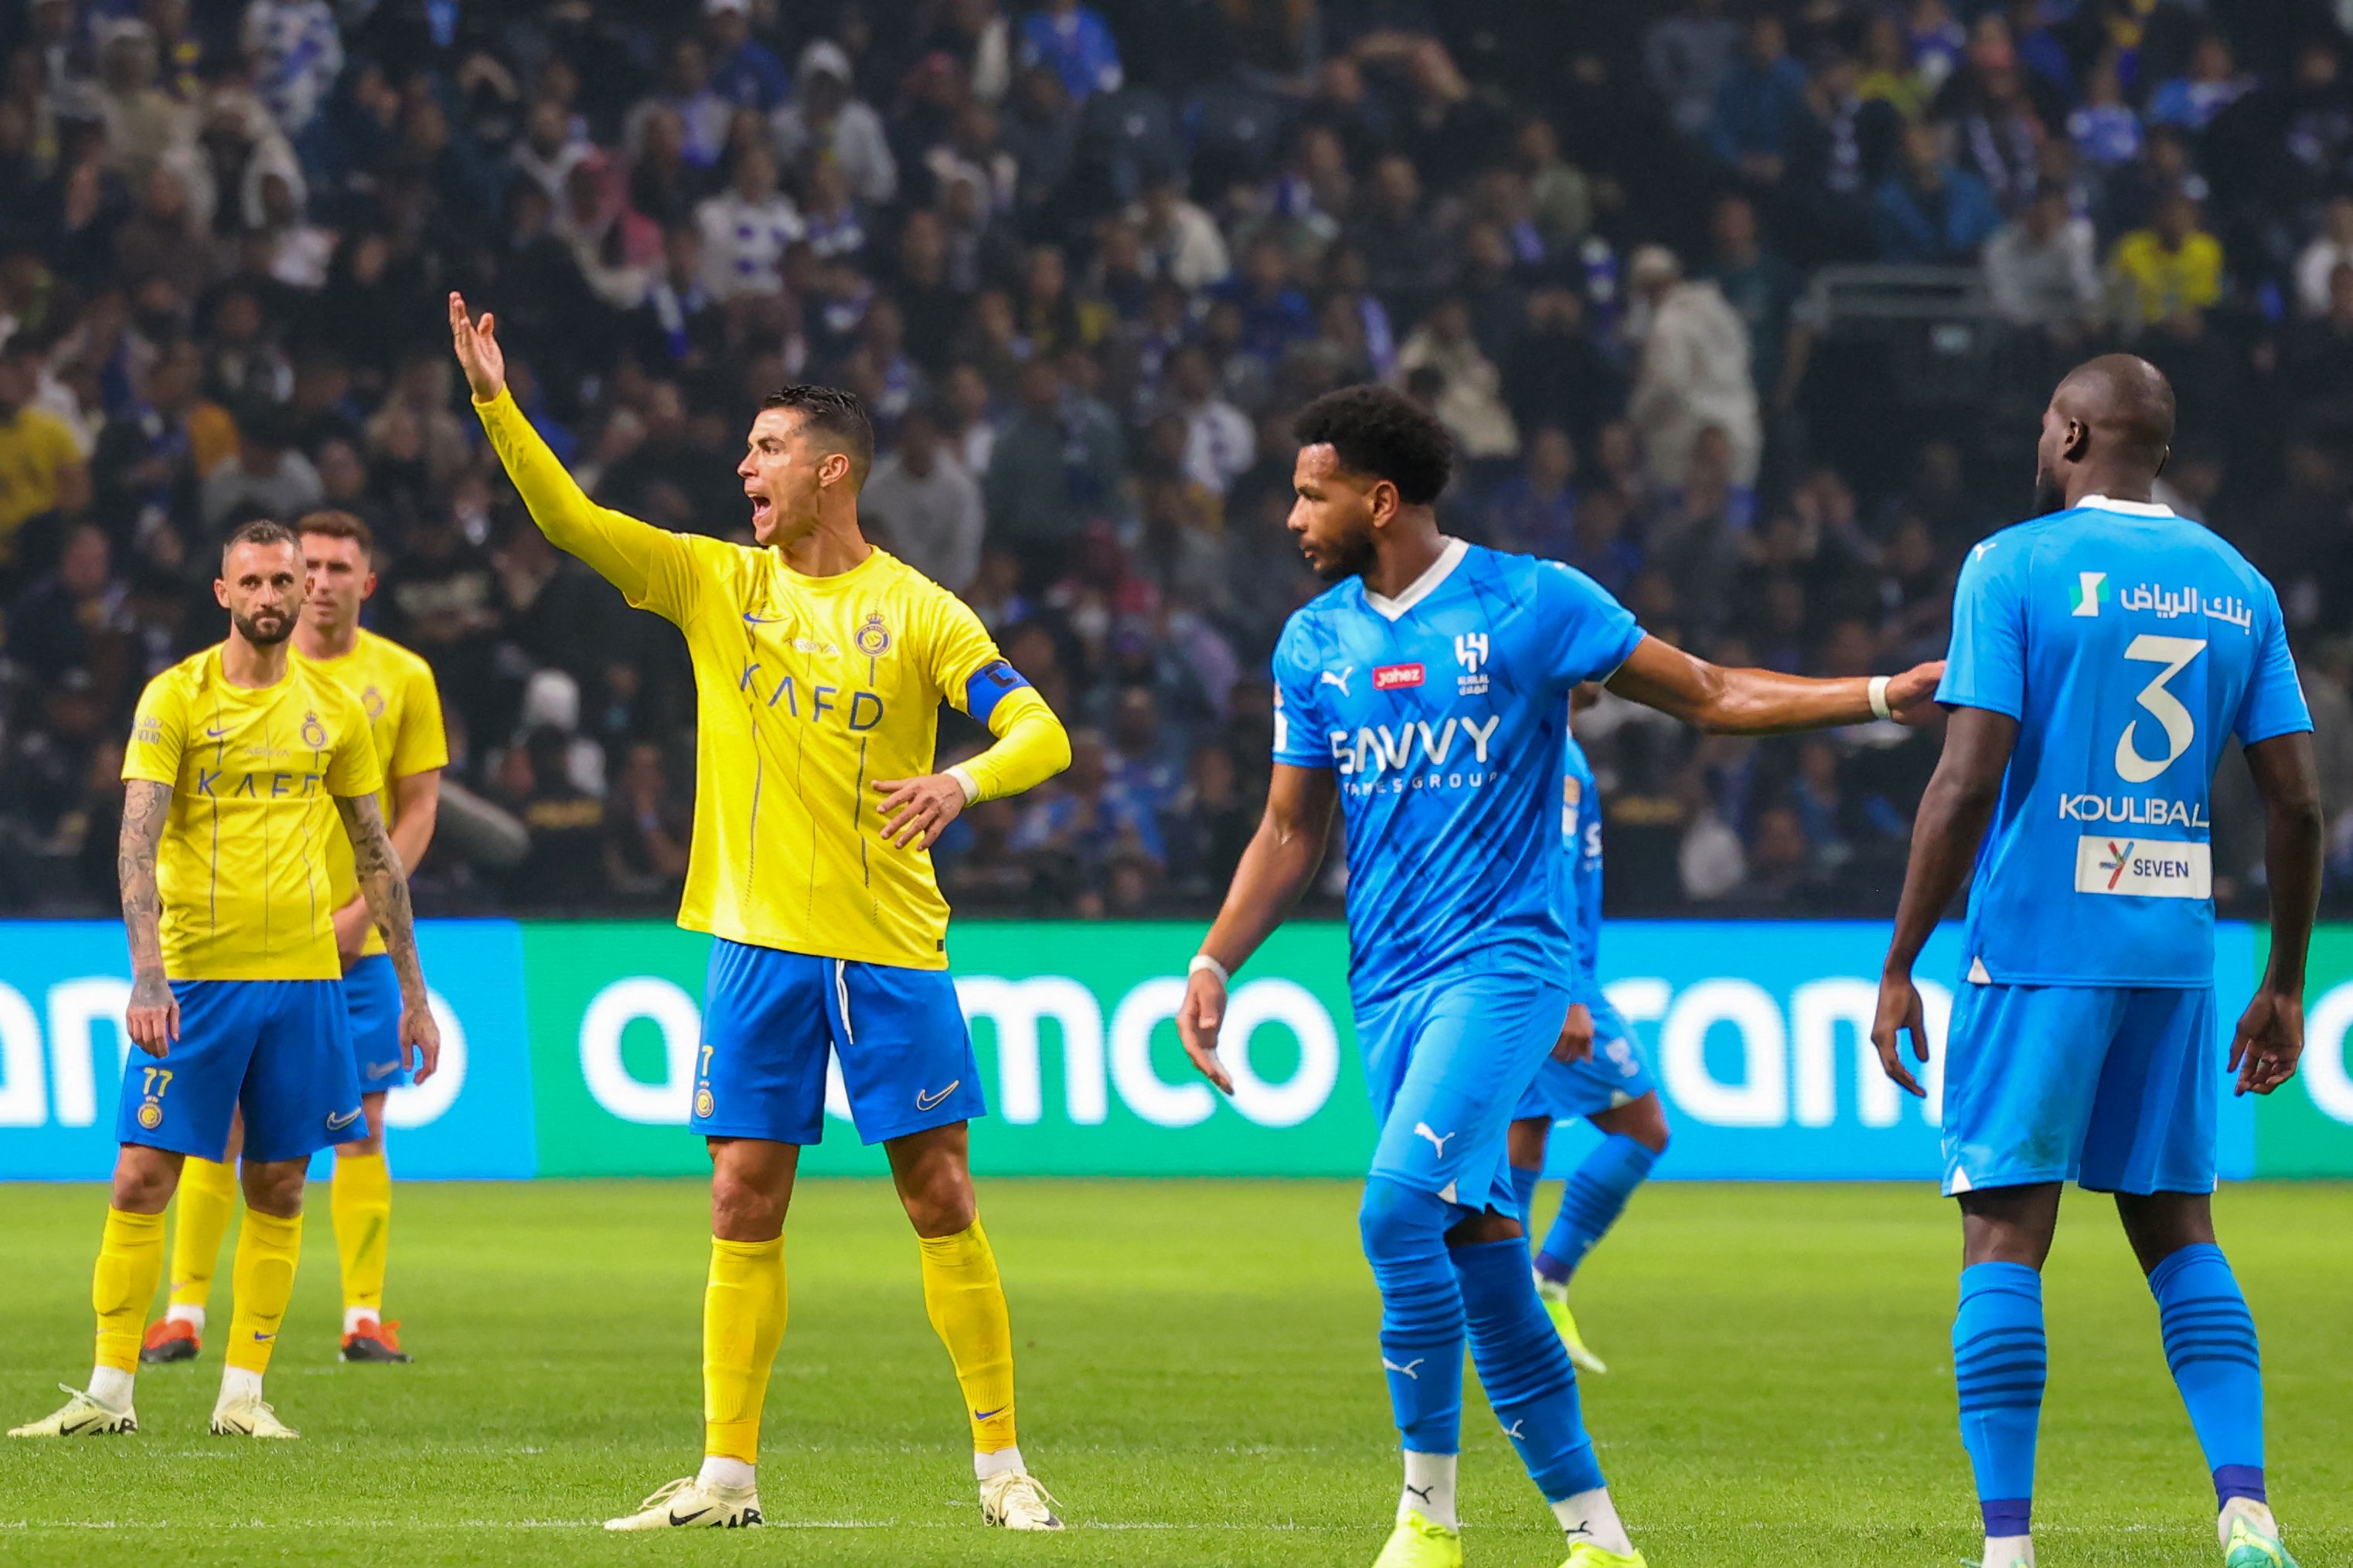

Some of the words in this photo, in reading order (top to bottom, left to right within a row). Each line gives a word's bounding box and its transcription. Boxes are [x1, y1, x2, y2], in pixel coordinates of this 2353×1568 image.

[2120, 583, 2198, 618] الرياض
[2201, 595, 2253, 635] بنك
[740, 659, 884, 730] KAFD
[1377, 668, 1421, 687] jahez
[2115, 634, 2208, 784] 3
[1330, 715, 1500, 774] SAVVY
[2059, 792, 2209, 828] KOULIBAL
[2133, 859, 2189, 878] SEVEN
[702, 1045, 713, 1077] 7
[143, 1067, 173, 1097] 77
